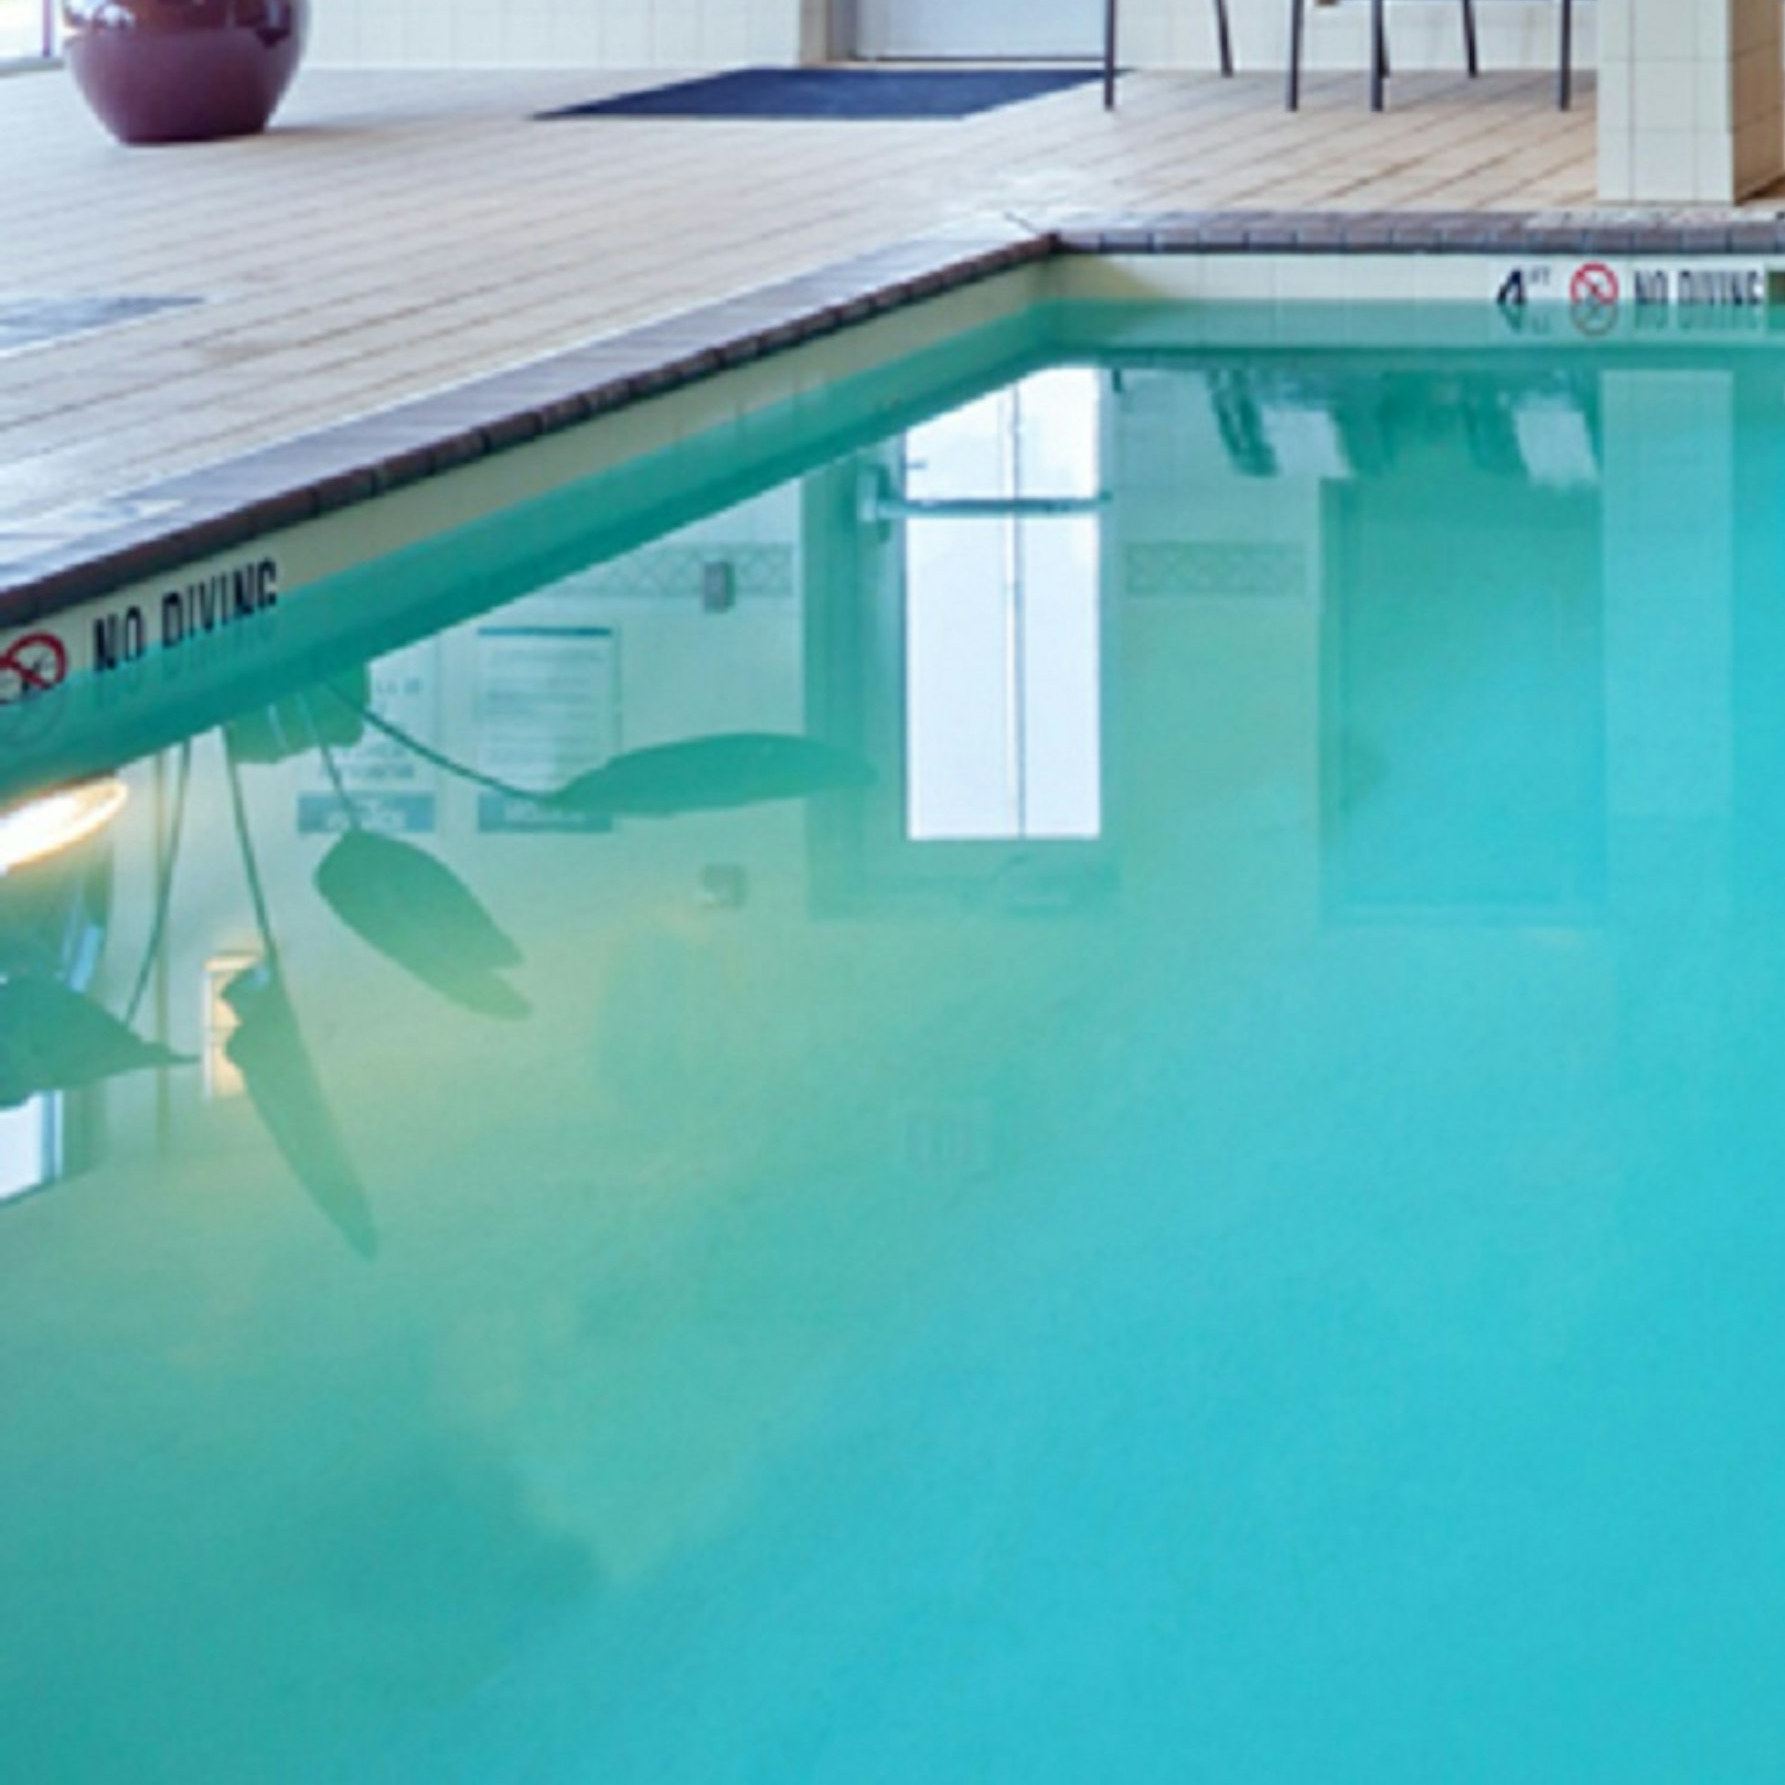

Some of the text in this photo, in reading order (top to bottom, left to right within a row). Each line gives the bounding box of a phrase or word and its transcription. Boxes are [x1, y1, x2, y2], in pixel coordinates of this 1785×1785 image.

[1497, 268, 1526, 306] 4
[1634, 270, 1668, 306] NO
[1678, 270, 1763, 306] DIVING
[94, 558, 278, 672] NO DIVING
